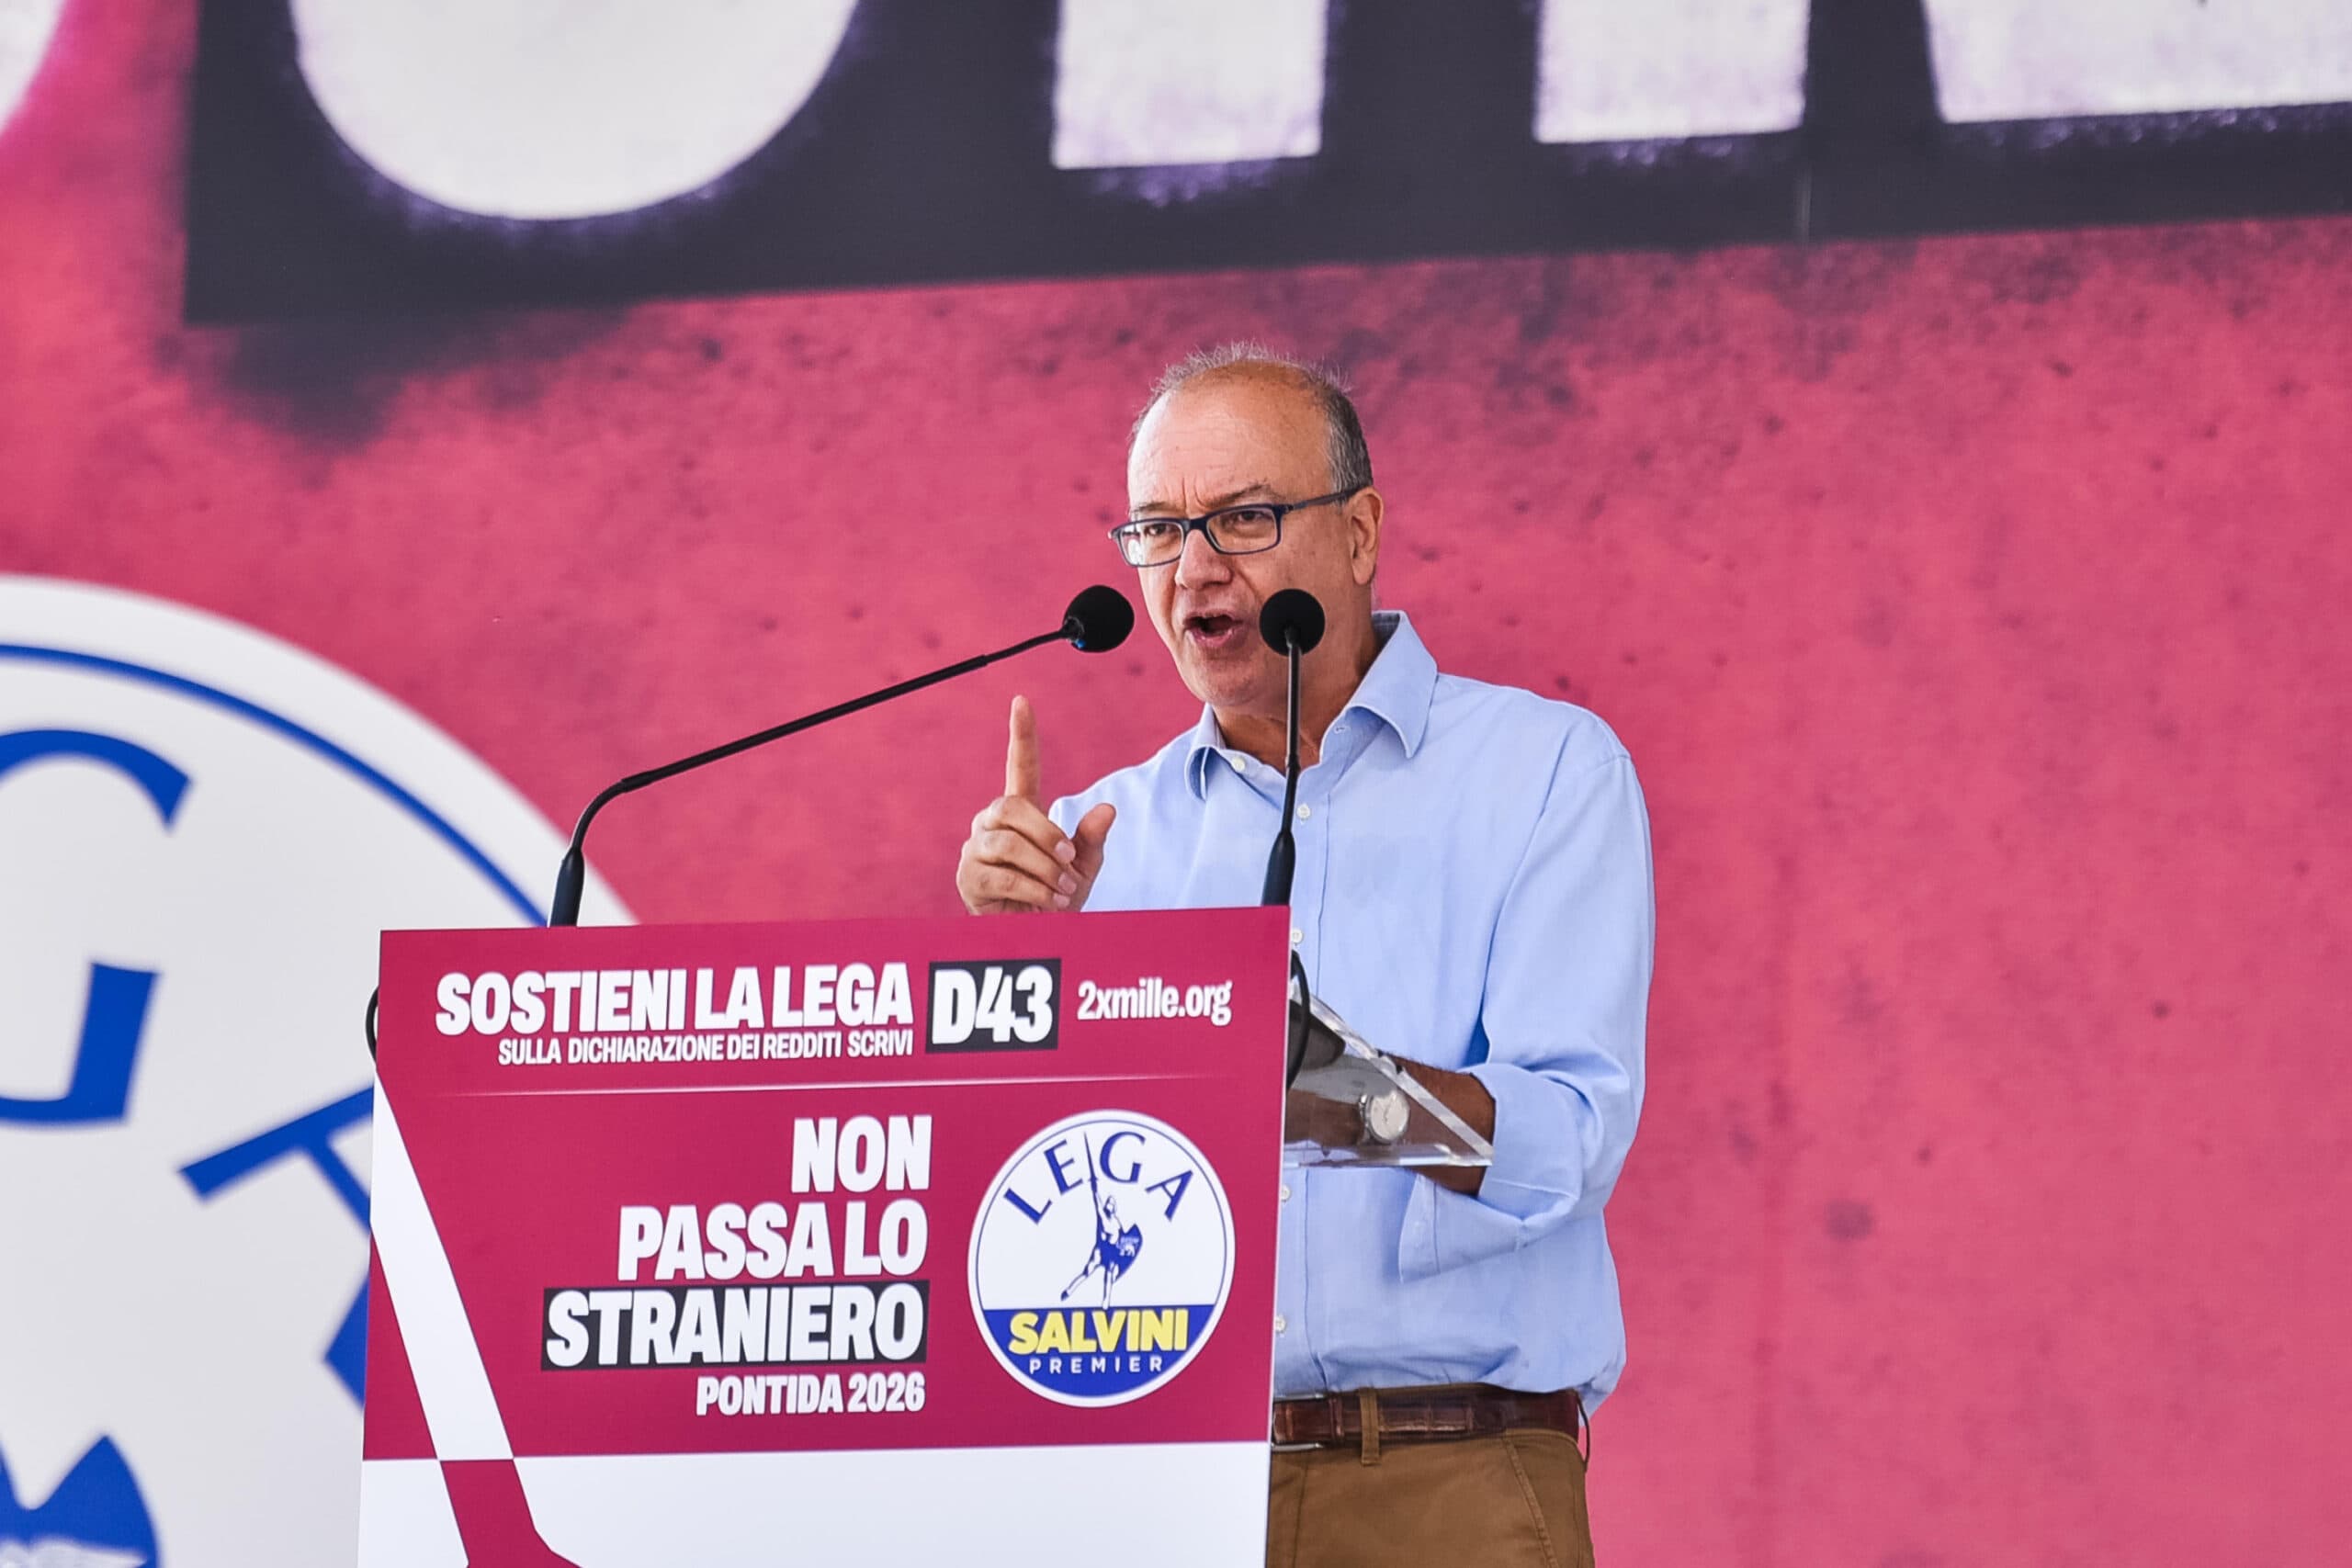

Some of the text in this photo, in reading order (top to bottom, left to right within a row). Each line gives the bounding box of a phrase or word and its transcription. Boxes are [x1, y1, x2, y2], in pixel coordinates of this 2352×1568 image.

[435, 962, 914, 1036] SOSTIENI LA LEGA
[932, 964, 1054, 1044] D43
[1076, 976, 1233, 1026] 2xmille.org
[498, 1028, 914, 1066] SULLA DICHIARAZIONE DEI REDDITI SCRIVI
[791, 1114, 933, 1193] NON
[1002, 1131, 1193, 1225] LEGA
[617, 1198, 929, 1281] PASSA LO
[546, 1282, 924, 1368] STRANIERO
[1008, 1308, 1189, 1355] SALVINI
[695, 1371, 926, 1416] PONTIDA 2026
[1029, 1355, 1163, 1374] PREMIER
